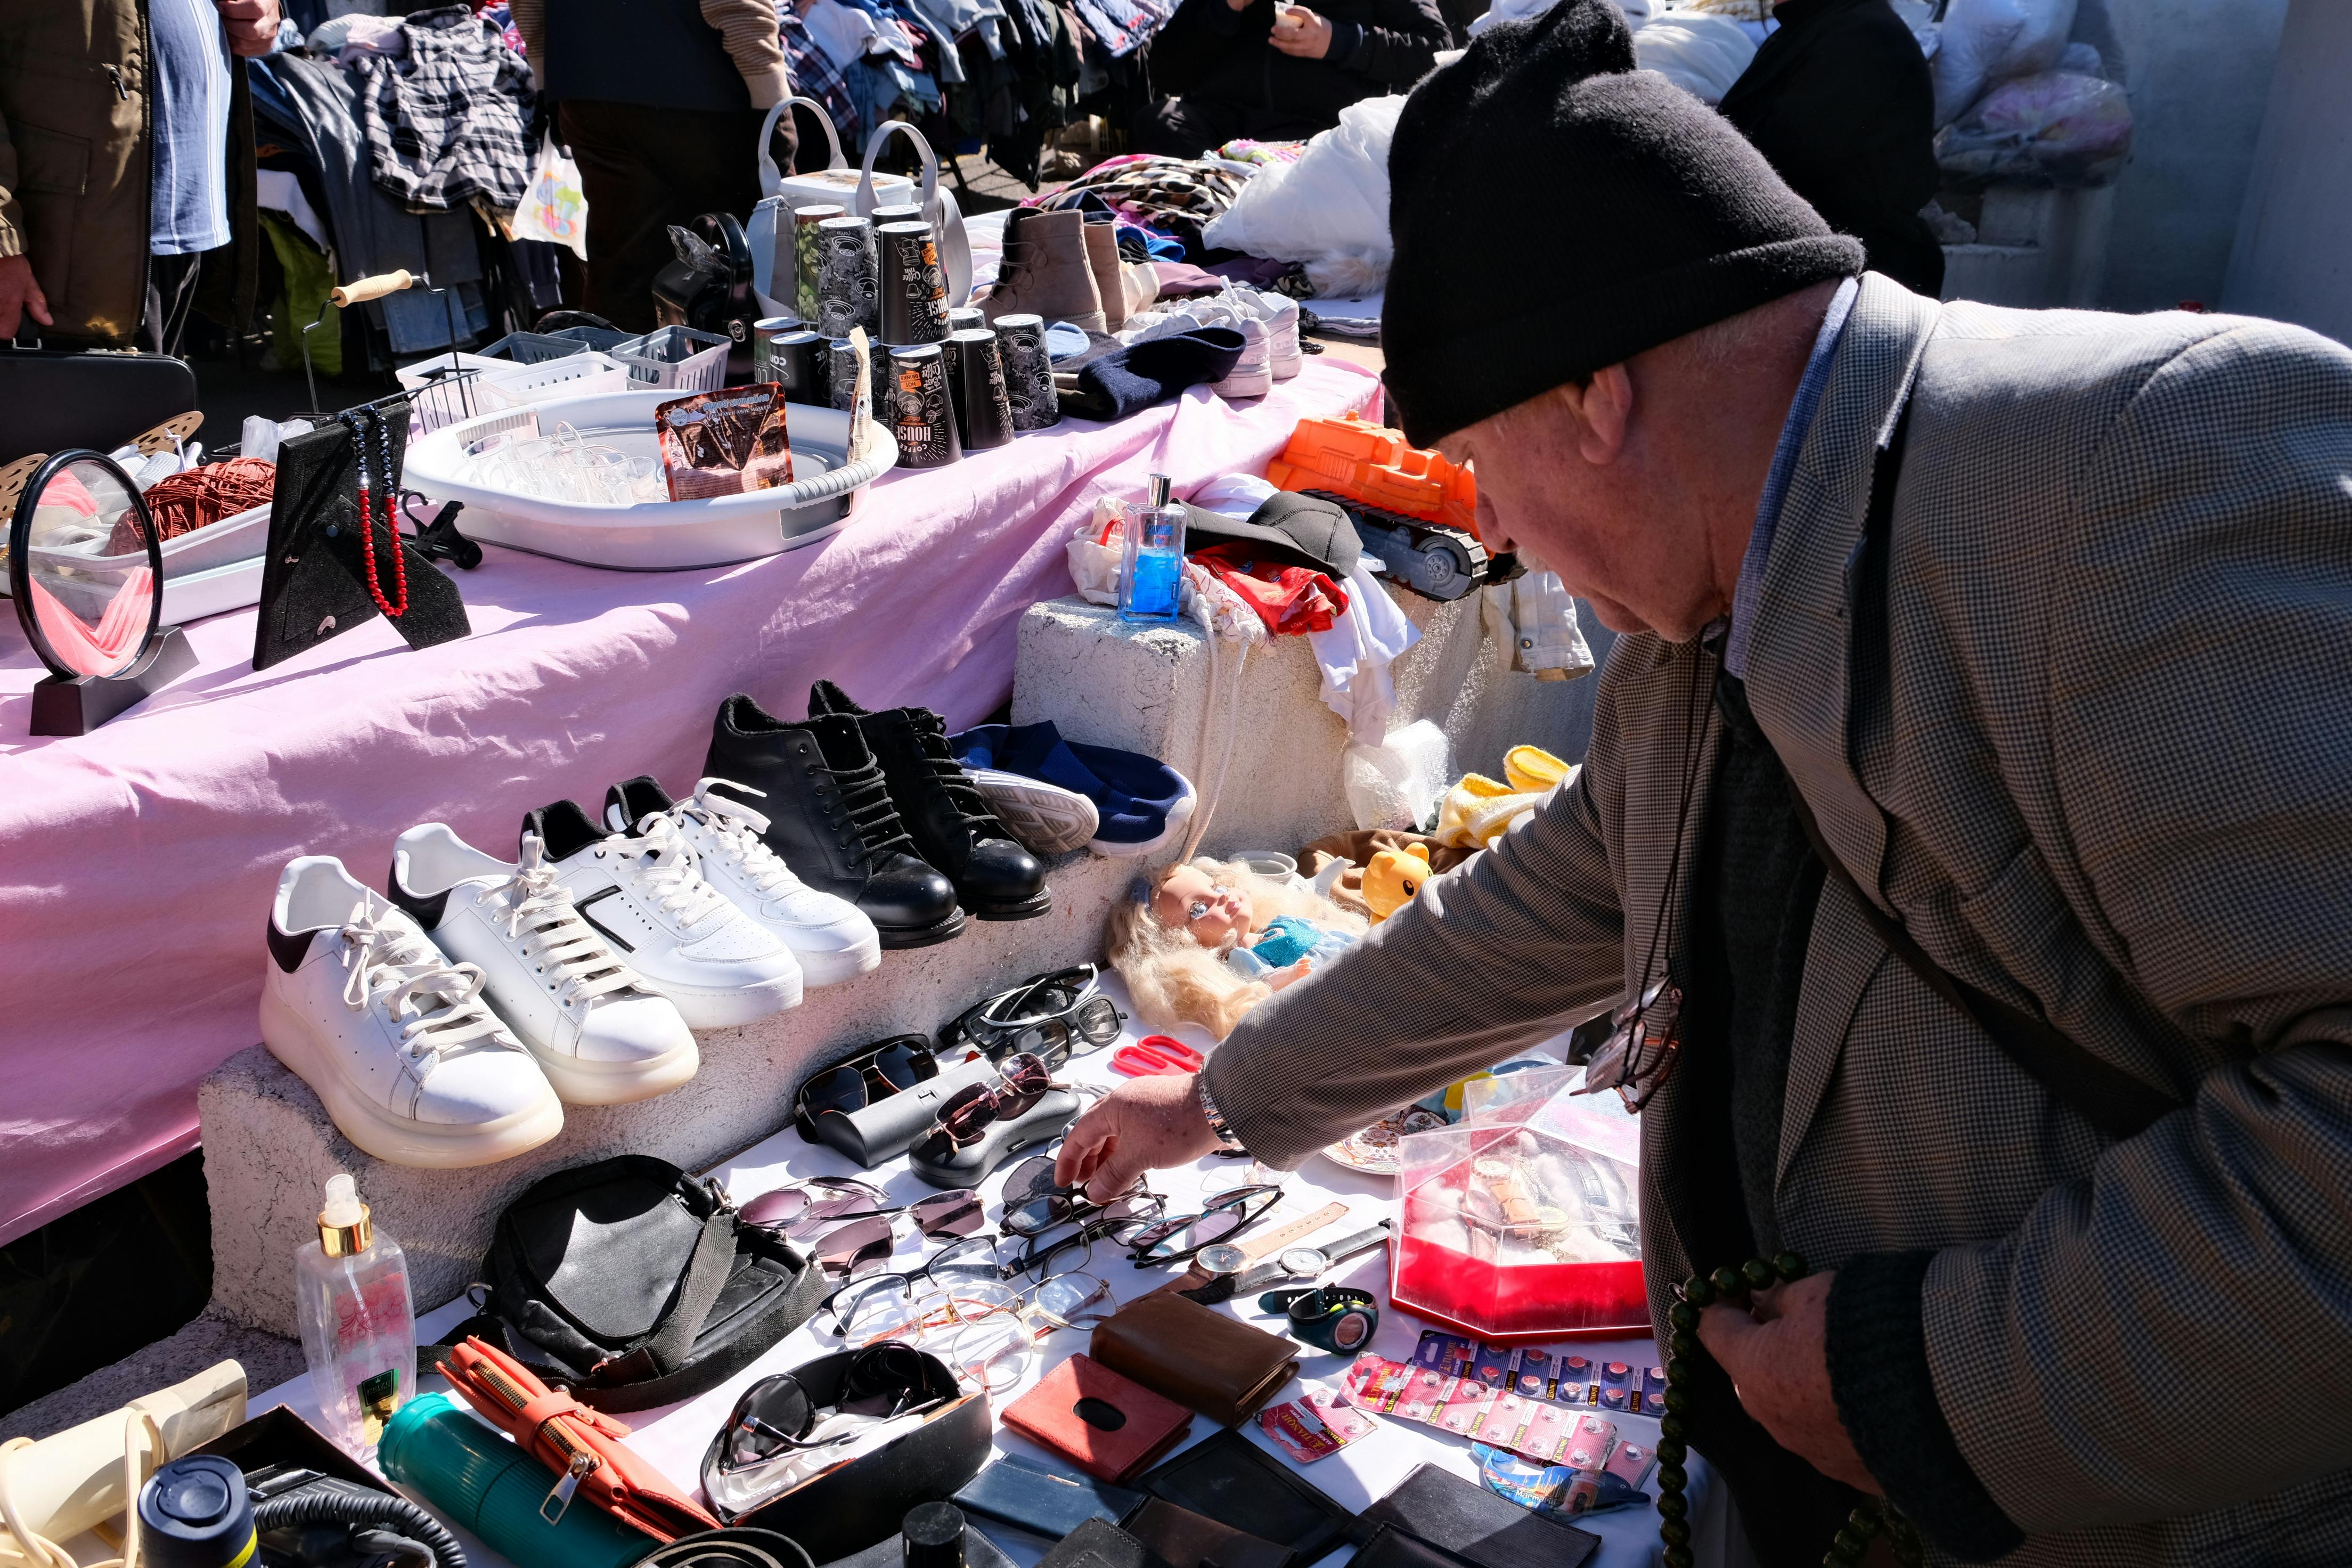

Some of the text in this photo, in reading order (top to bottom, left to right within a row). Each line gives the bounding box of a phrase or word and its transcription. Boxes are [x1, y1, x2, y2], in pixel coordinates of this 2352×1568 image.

[833, 271, 847, 284] Coffee
[902, 271, 921, 282] Coffee
[921, 361, 941, 378] Coffee
[1011, 367, 1026, 379] Coffee
[924, 375, 942, 389] Best
[703, 394, 770, 412] MERRY SATURDAY
[895, 425, 932, 442] HOUSE
[899, 442, 928, 453] COFFEE
[1442, 1341, 1457, 1367] TIANQIU
[1371, 1366, 1392, 1394] TIANQIU
[1281, 1412, 1313, 1441] TIANQIU
[1515, 1489, 1556, 1506] Marmaris
